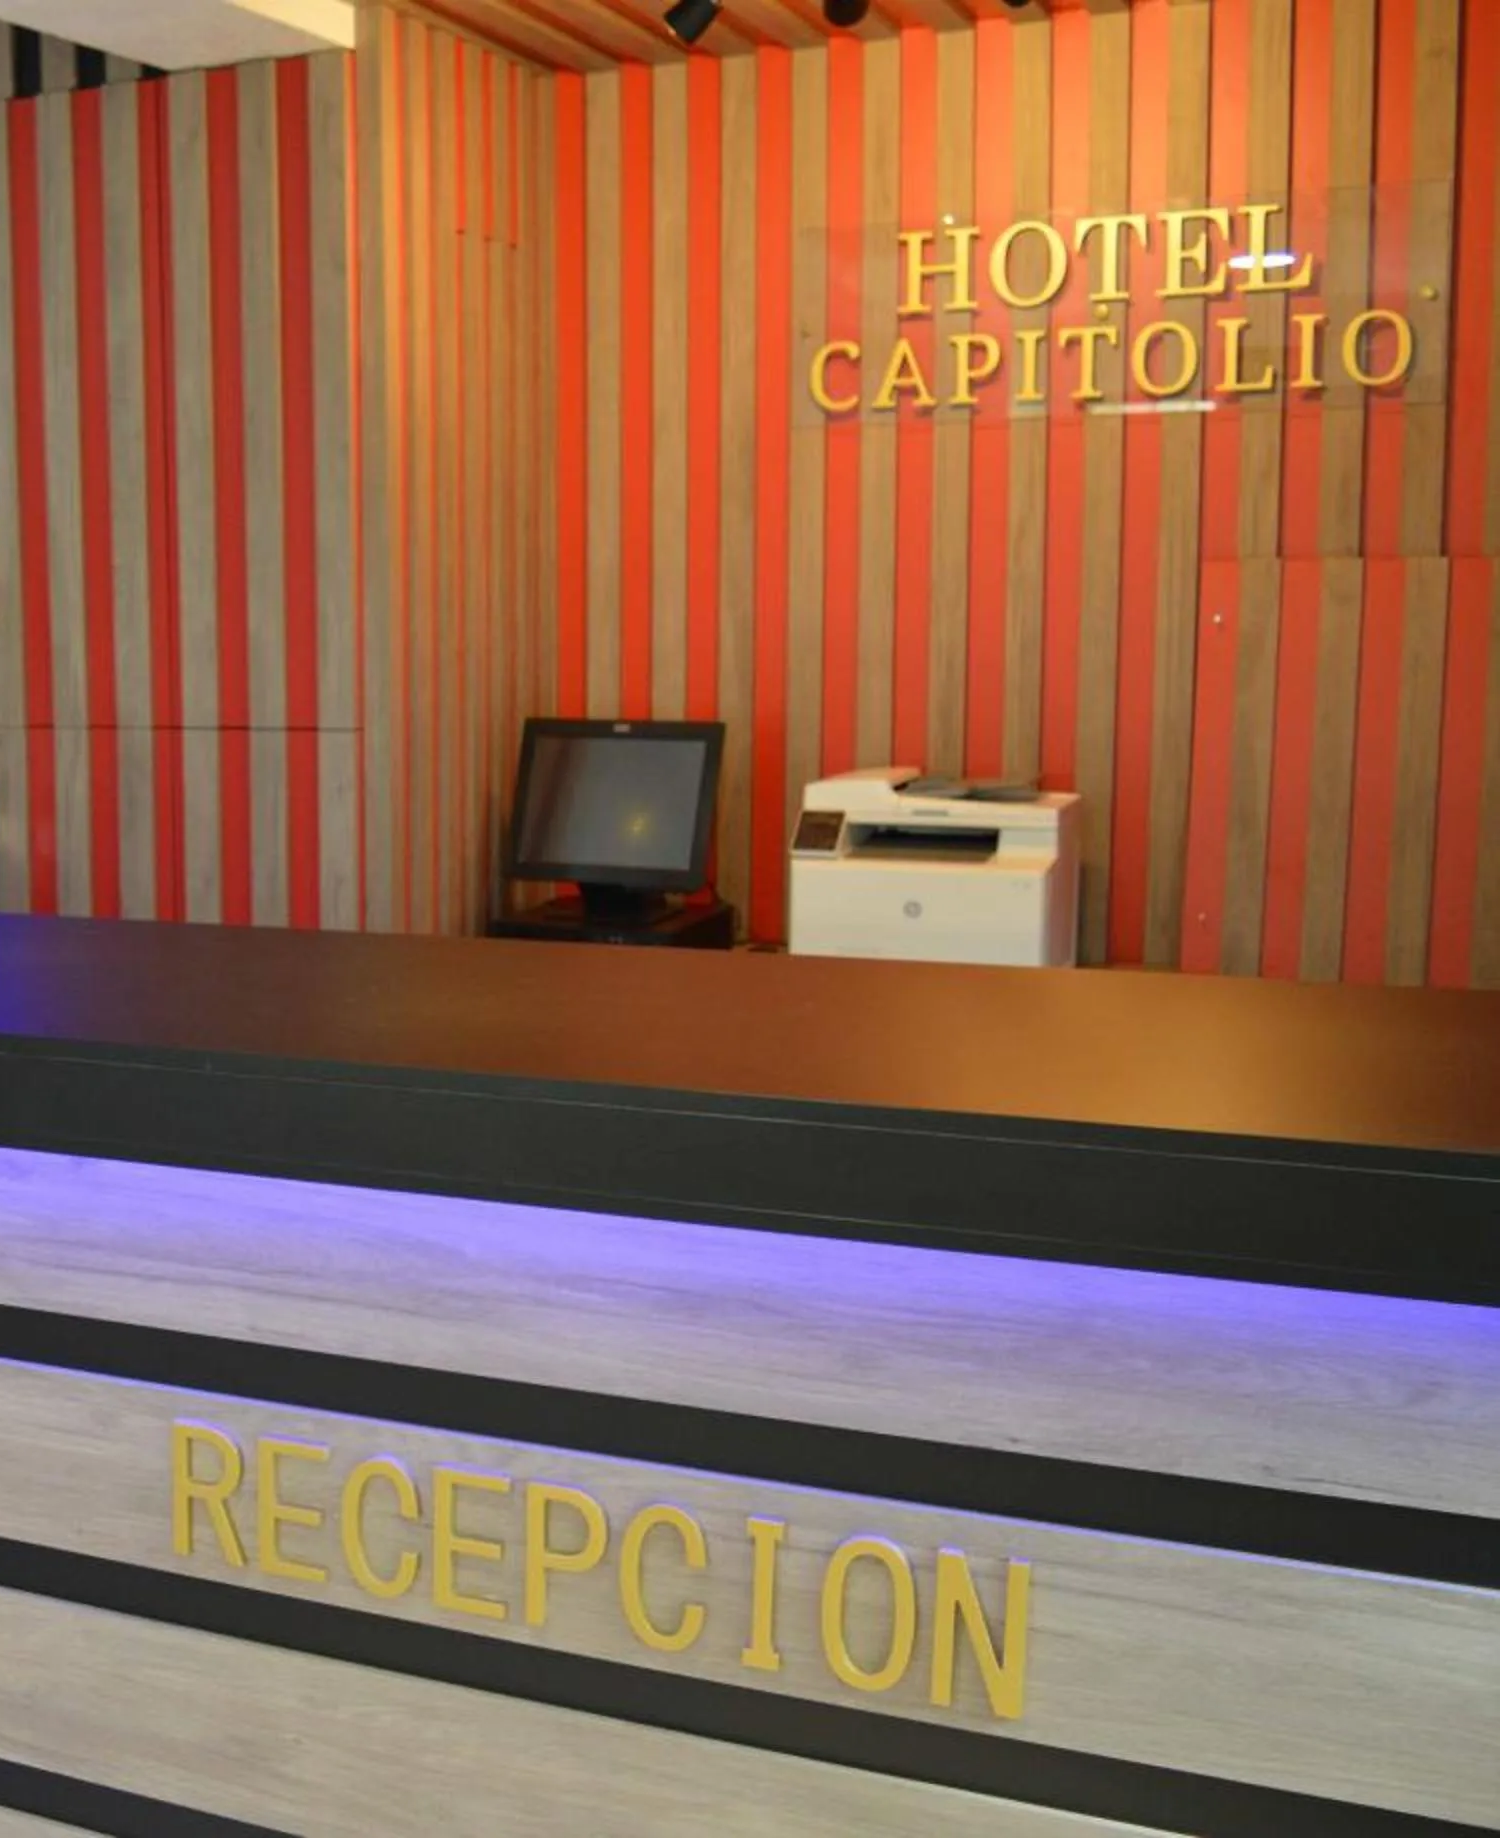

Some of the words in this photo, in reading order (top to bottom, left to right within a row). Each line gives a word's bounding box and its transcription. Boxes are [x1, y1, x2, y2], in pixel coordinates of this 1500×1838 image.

[897, 205, 1313, 313] HOTEL
[810, 310, 1413, 412] CAPITOLIO
[172, 1419, 1031, 1719] RECEPCION
